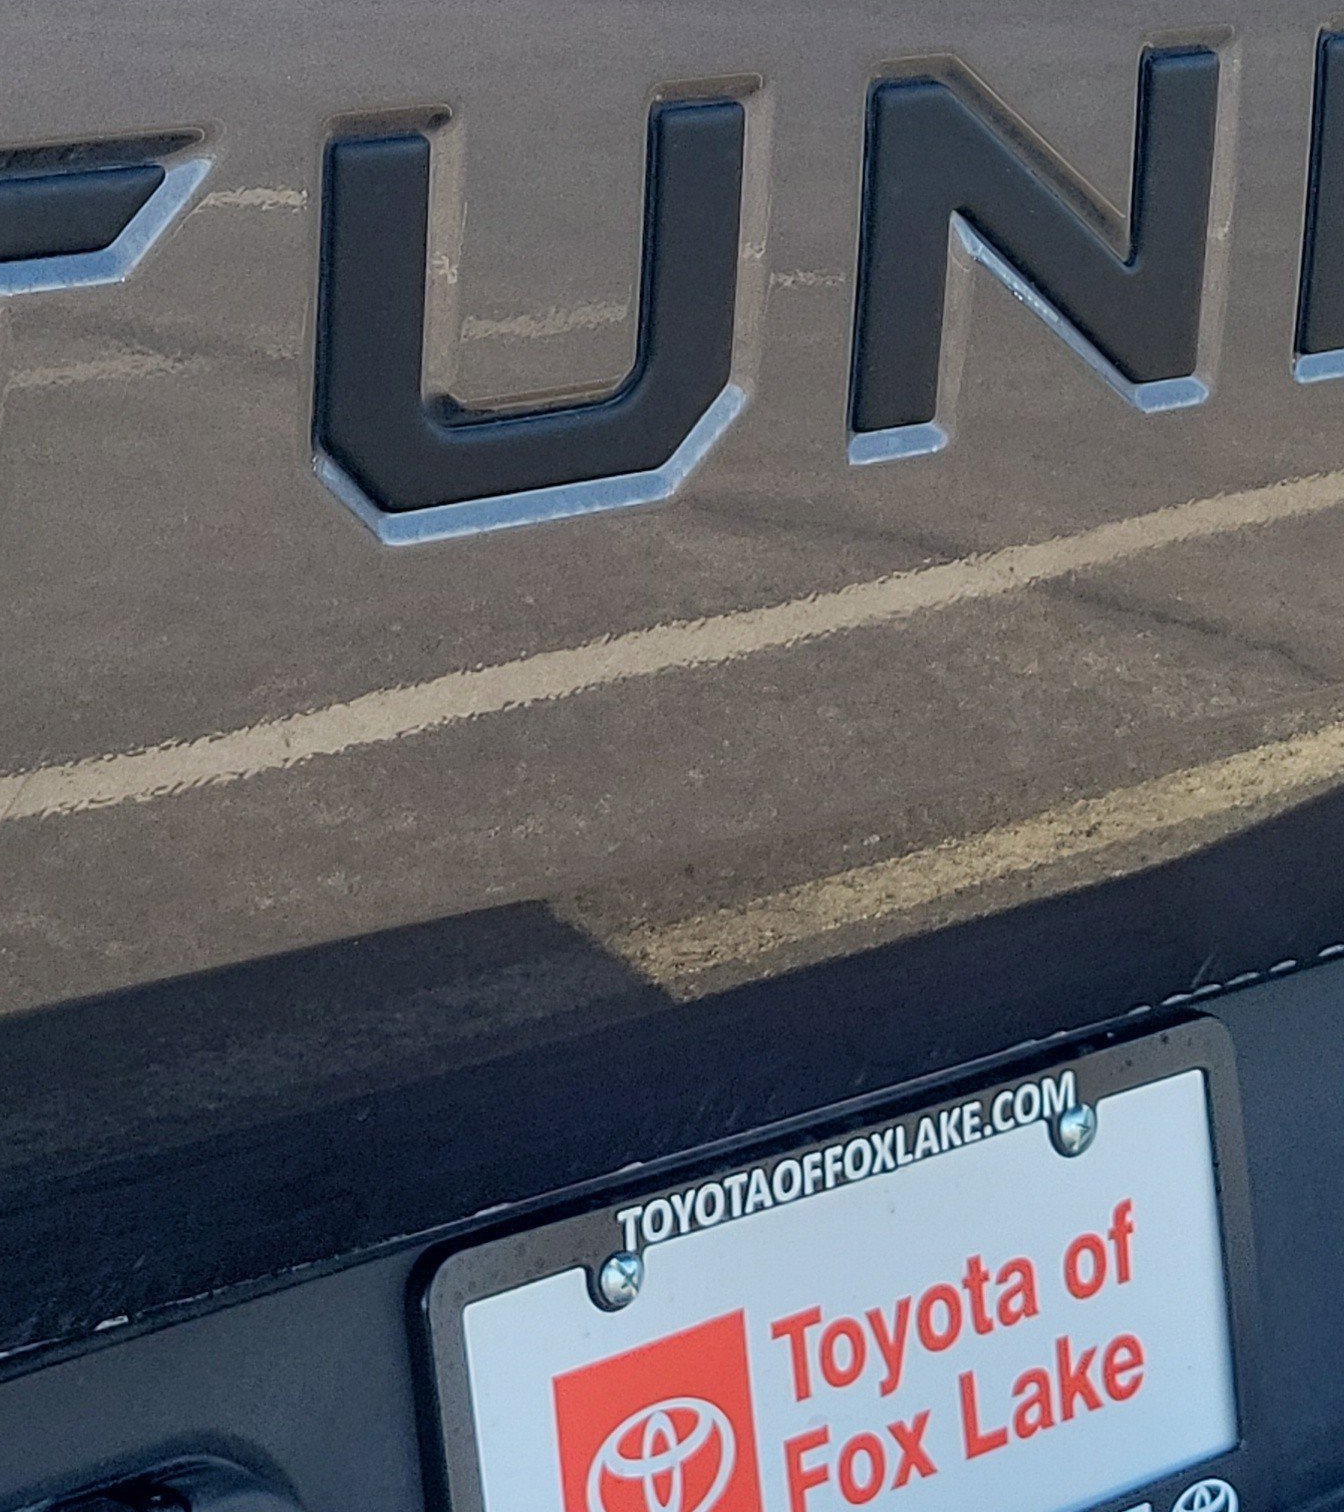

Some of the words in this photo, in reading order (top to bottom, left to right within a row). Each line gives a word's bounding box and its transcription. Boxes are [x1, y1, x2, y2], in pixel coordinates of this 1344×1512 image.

[616, 1069, 1077, 1251] TOYOTAOFFOXLAKE.COM
[770, 1253, 1040, 1403] Toyota
[1062, 1197, 1135, 1301] of
[782, 1408, 939, 1512] Fox
[958, 1332, 1146, 1461] Lake
